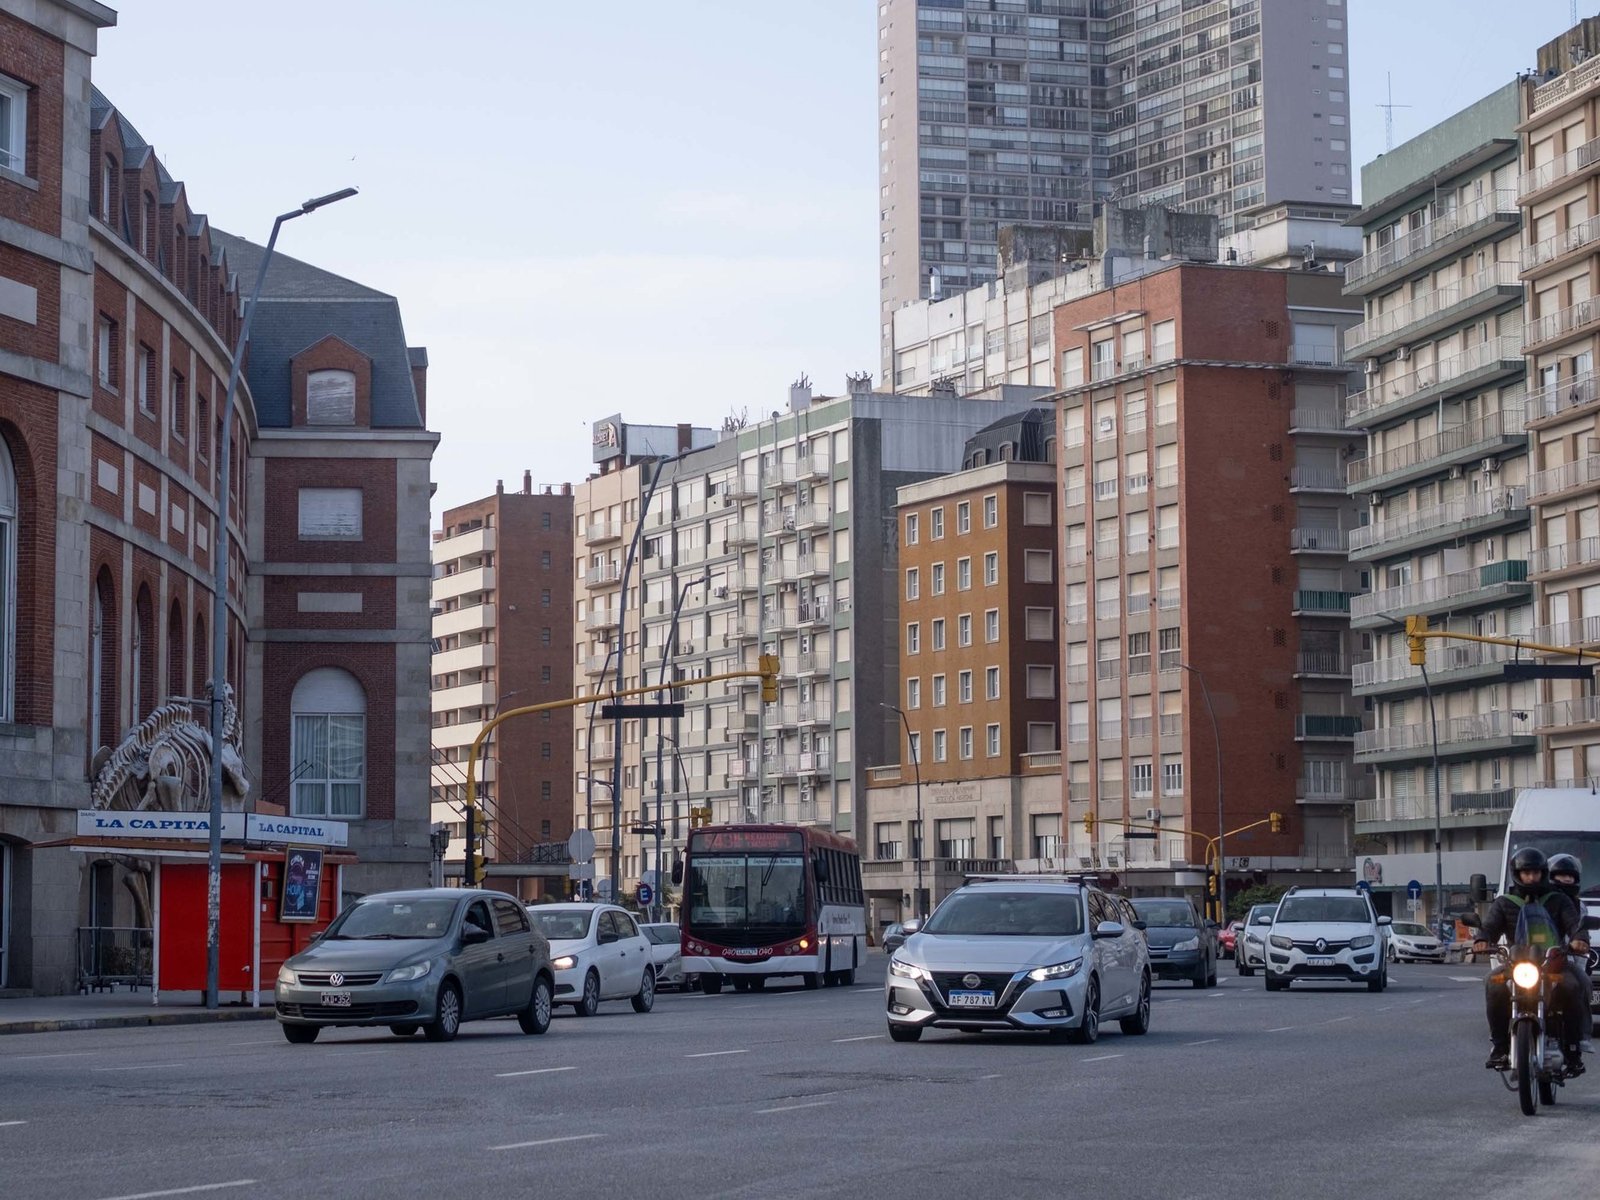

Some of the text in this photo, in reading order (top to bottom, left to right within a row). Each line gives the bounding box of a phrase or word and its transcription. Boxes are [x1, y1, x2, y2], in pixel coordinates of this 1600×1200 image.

[95, 818, 226, 830] LA CAPITA
[259, 822, 324, 837] LA CAPITAL
[641, 888, 648, 901] E
[951, 995, 962, 1004] AF
[965, 995, 979, 1004] 787
